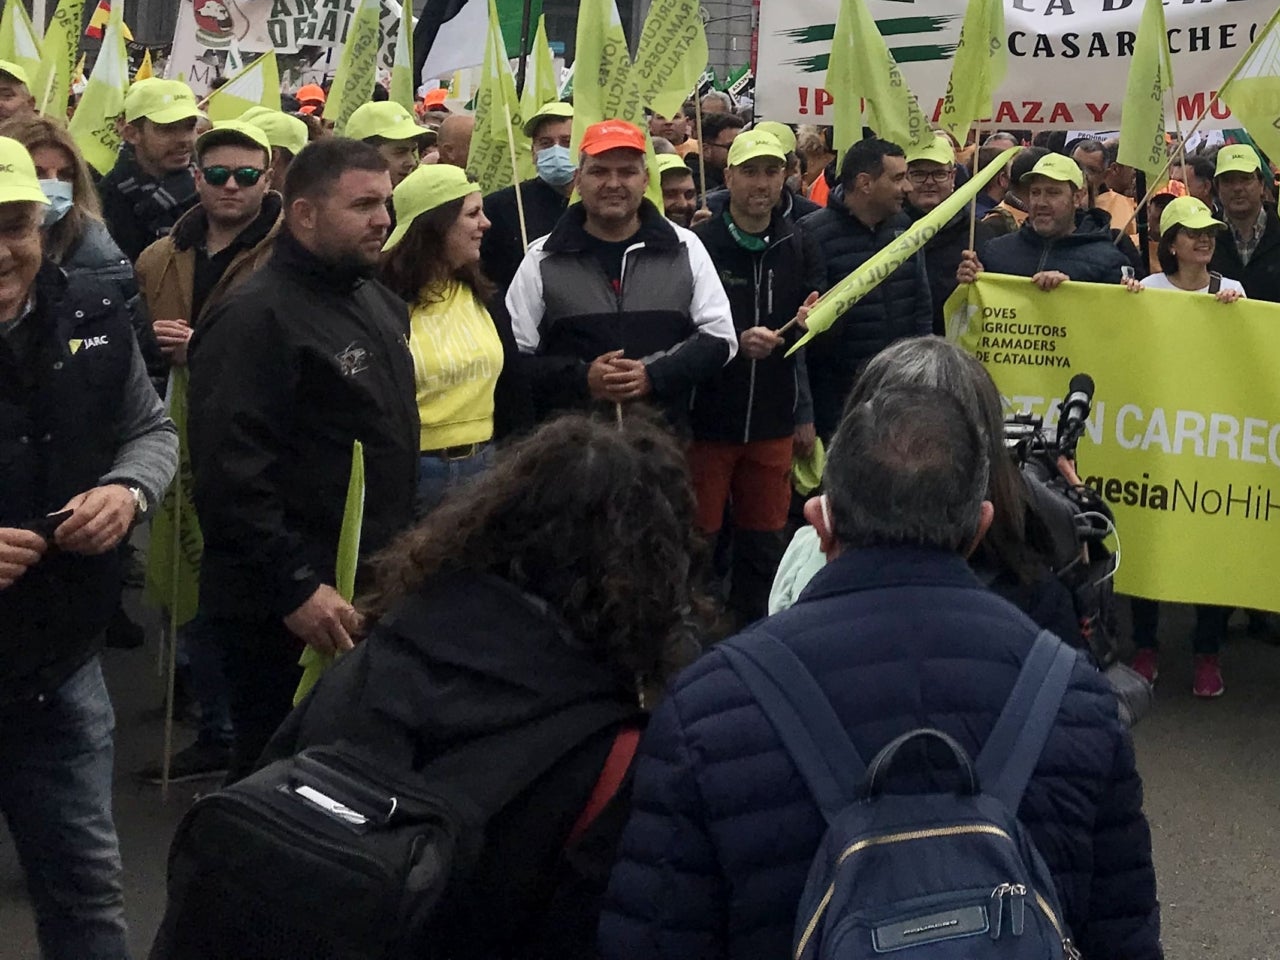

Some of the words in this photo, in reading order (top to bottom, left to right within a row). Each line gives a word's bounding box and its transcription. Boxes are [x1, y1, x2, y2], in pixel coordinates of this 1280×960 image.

[1008, 23, 1237, 58] CASARCHE
[1085, 103, 1110, 124] Y
[982, 306, 1017, 320] OVES
[83, 335, 109, 349] JARC
[982, 336, 1056, 352] RAMADERS
[993, 352, 1071, 368] CATALUNYA
